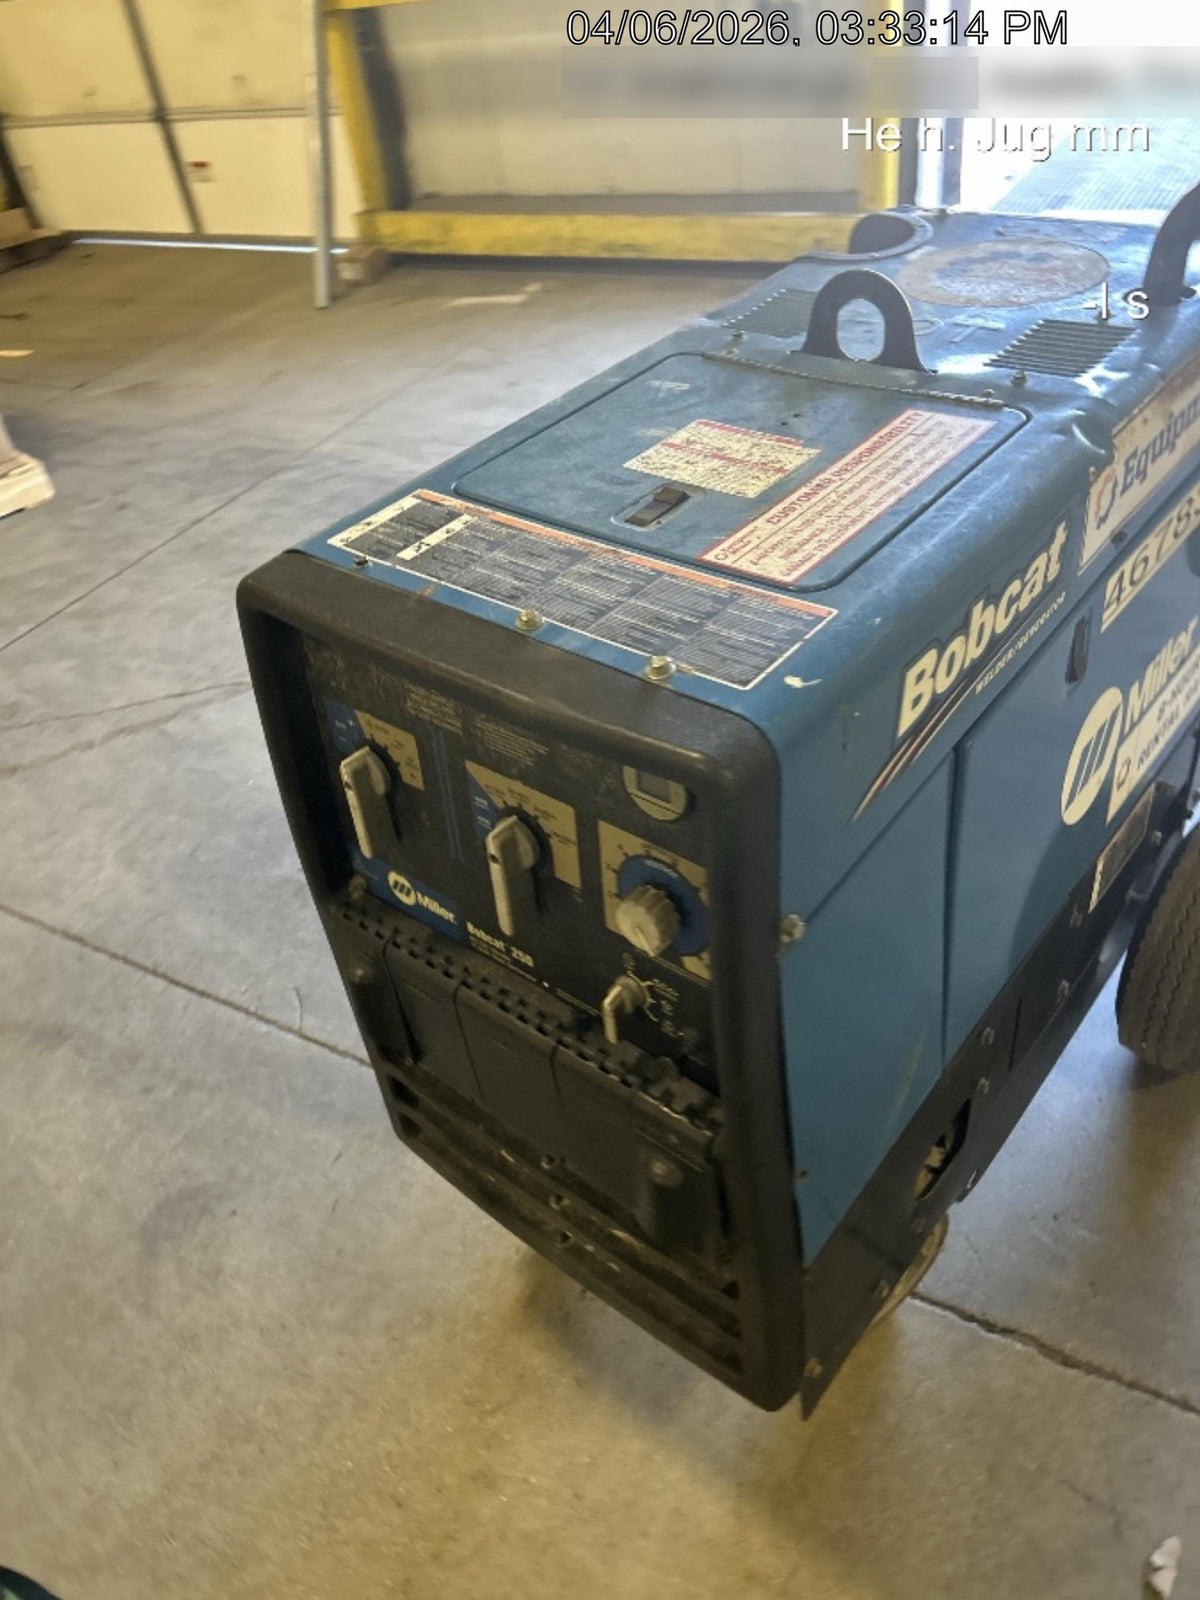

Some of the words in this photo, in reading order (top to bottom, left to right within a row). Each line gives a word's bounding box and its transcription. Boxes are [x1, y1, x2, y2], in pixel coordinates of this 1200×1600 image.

[766, 475, 836, 525] CUSTOMER
[833, 411, 924, 478] RESPONSIBILITY
[1105, 486, 1200, 608] 4678
[897, 521, 1068, 738] Bobcat
[1124, 614, 1199, 737] Miller
[415, 892, 457, 923] Miller
